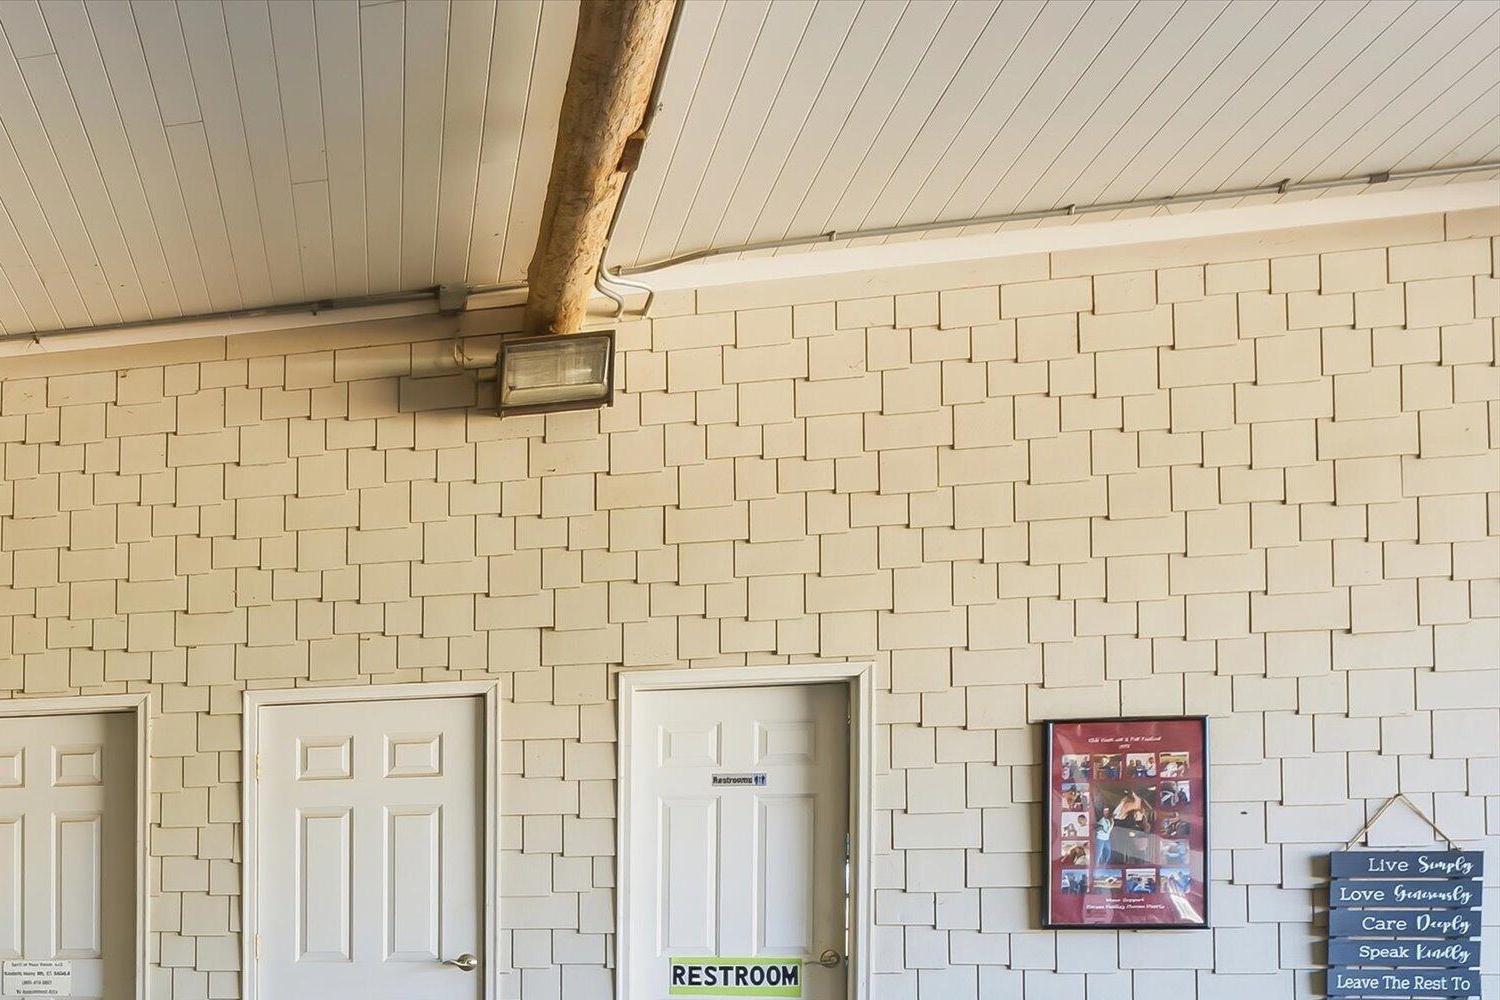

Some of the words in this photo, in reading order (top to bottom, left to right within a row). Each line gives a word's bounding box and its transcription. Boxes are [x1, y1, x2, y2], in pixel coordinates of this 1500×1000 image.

[712, 775, 753, 785] Restrooms
[1368, 857, 1409, 872] Live
[1418, 855, 1474, 875] Simply
[1340, 887, 1385, 902] Love
[1394, 884, 1473, 904] Generously
[1362, 917, 1407, 931] Care
[1416, 914, 1472, 934] Deeply
[1359, 945, 1409, 960] Speak
[1416, 944, 1472, 963] Kindly
[672, 964, 799, 986] RESTROOM
[1337, 975, 1379, 990] Leave
[1382, 975, 1410, 990] The
[1414, 976, 1448, 990] Rest
[1451, 977, 1471, 991] To
